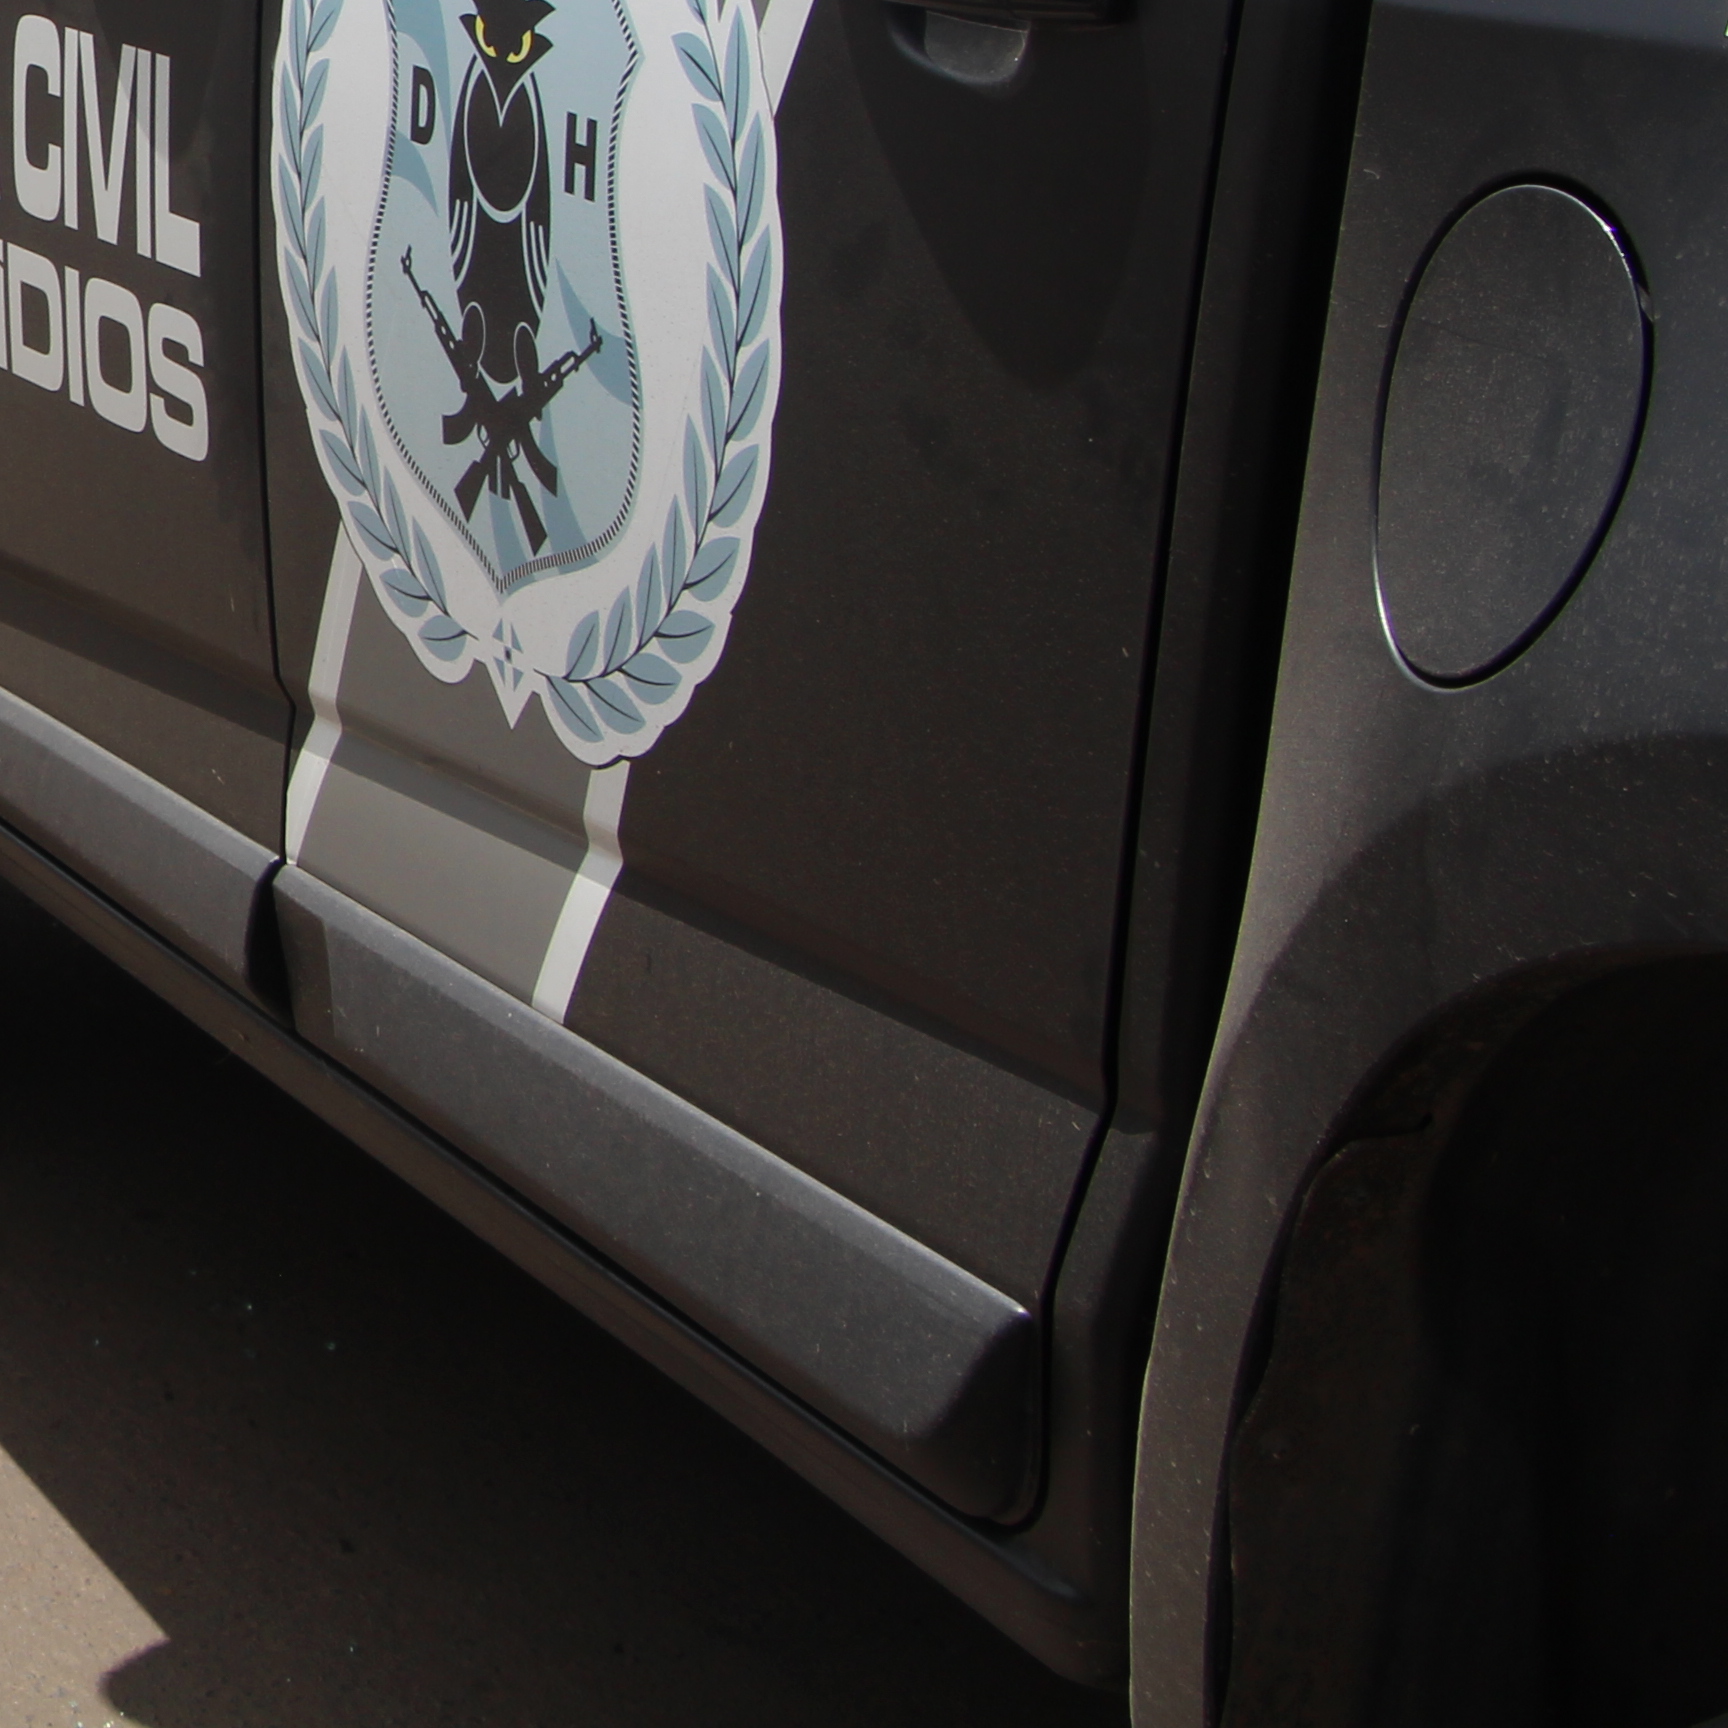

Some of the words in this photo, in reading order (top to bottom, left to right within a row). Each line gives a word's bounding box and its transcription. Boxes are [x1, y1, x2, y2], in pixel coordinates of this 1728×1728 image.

[13, 15, 201, 277] CIVIL
[410, 65, 436, 145] D
[564, 111, 598, 203] H
